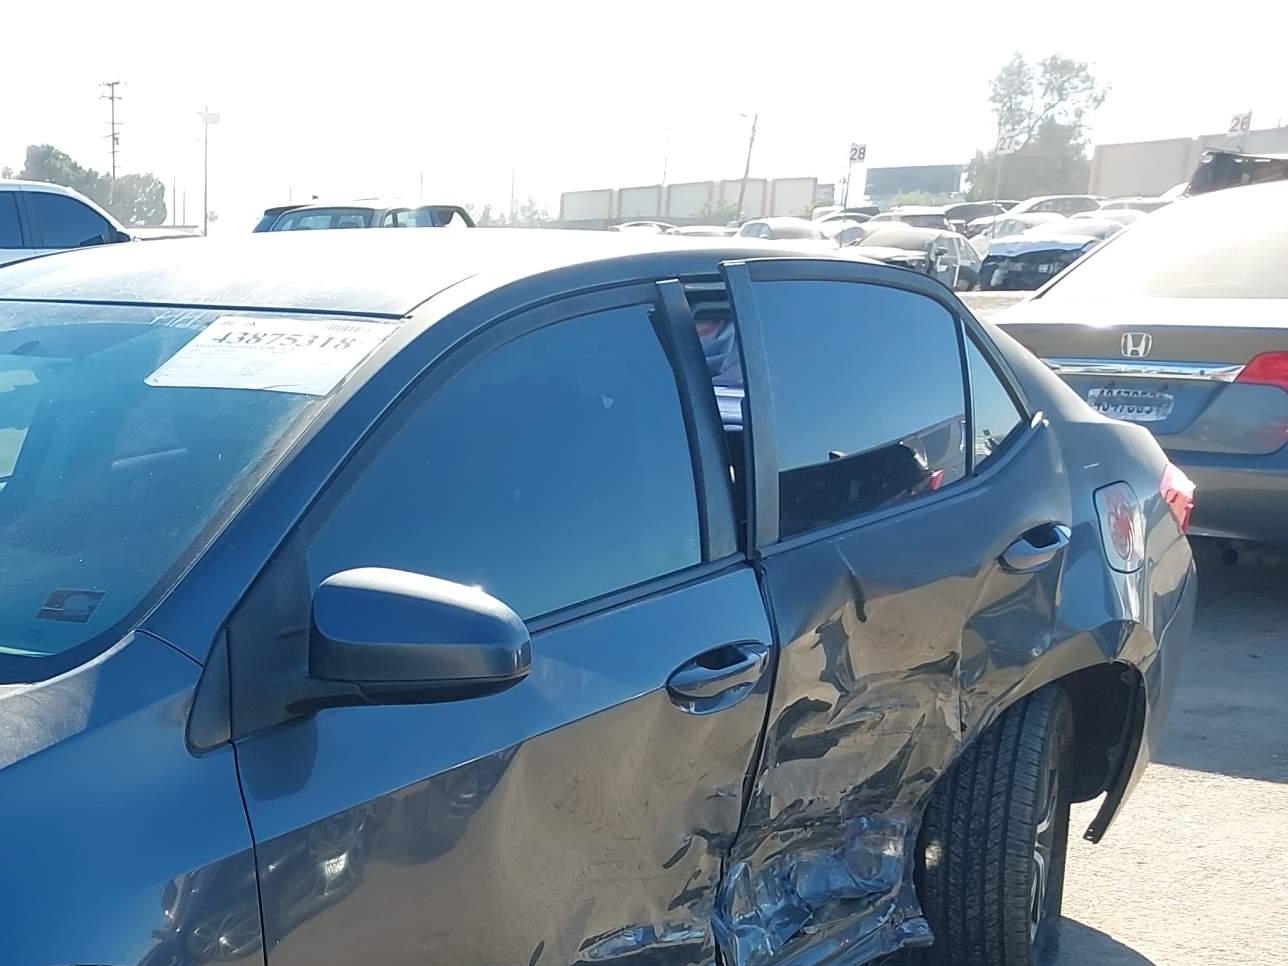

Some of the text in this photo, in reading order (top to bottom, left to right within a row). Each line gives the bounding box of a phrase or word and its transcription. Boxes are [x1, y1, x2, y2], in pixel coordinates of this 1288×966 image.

[999, 135, 1016, 151] 27
[850, 147, 866, 161] 28
[213, 331, 357, 350] 43875318
